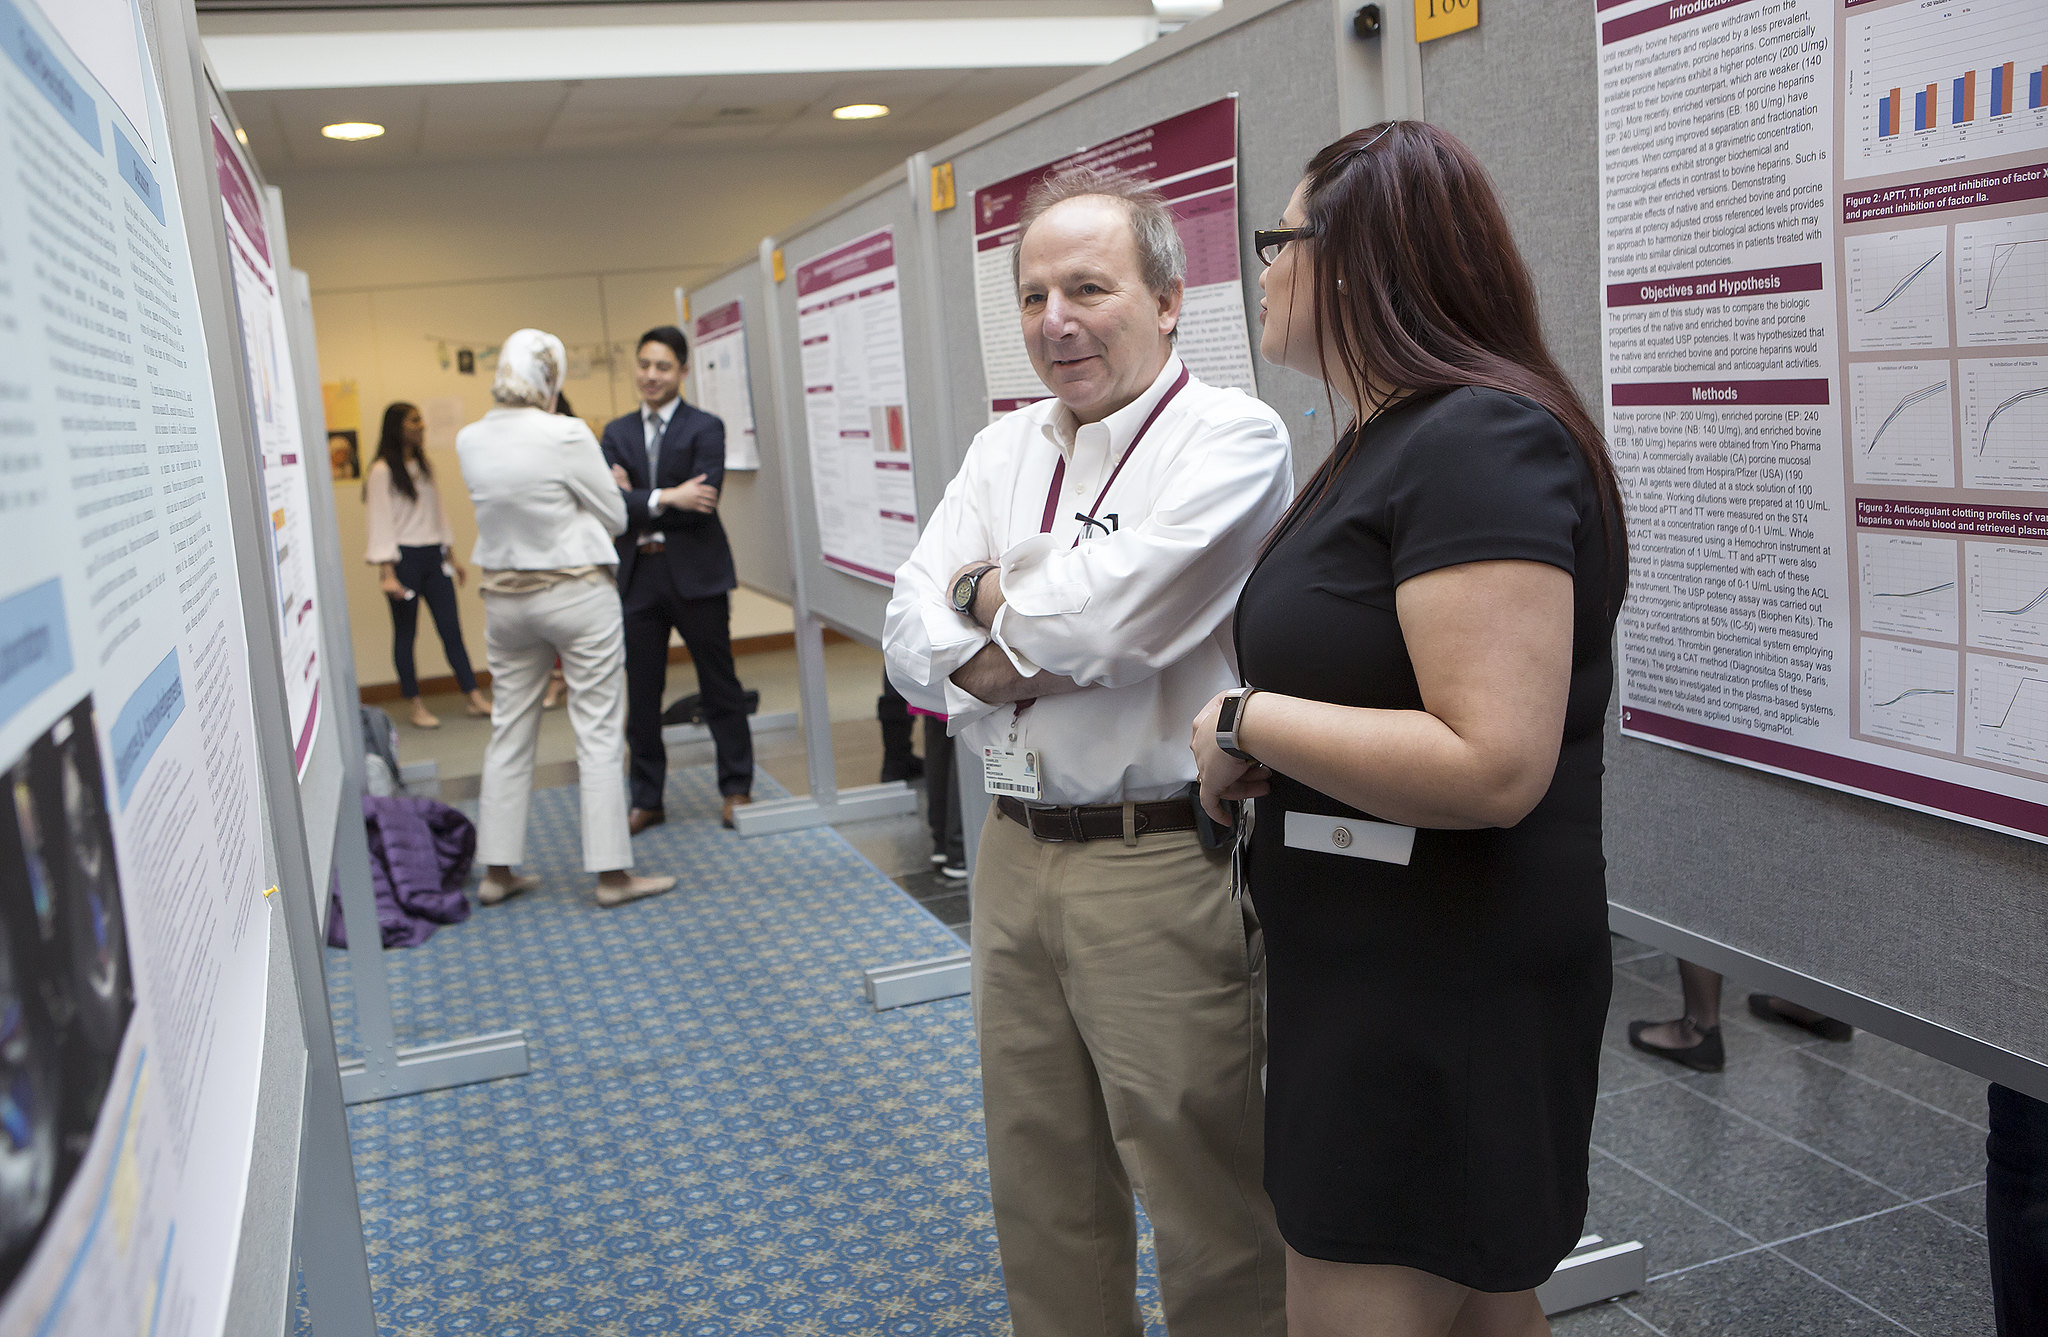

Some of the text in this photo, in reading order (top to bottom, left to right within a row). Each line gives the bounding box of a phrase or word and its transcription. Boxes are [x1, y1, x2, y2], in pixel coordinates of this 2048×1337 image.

[1670, 0, 1734, 20] Introduc
[1762, 0, 1795, 16] from the
[1750, 23, 1766, 35] less
[1758, 24, 1815, 48] Commercially
[1719, 36, 1827, 74] higher potency (200 U/mg)
[1769, 54, 1821, 76] weaker (140
[1746, 74, 1814, 99] porcine heparins
[1760, 91, 1807, 108] U/mg) have
[1710, 105, 1817, 135] separation and fractionation
[1715, 132, 1755, 150] gravimetric
[1727, 140, 1788, 161] biochemical and
[1795, 150, 1816, 164] Such
[1731, 173, 1785, 190] Demonstrating
[1748, 183, 1822, 202] bovine and porcine
[1846, 197, 1871, 207] Figure
[1873, 193, 1880, 203] 2:
[1882, 190, 1906, 201] APTT,
[1909, 188, 1921, 198] TT,
[1923, 183, 1956, 197] percent
[1958, 178, 1999, 190] inhibition
[2002, 174, 2011, 184] of
[2013, 172, 2040, 182] factor
[1724, 198, 1824, 220] referenced levels provides
[1845, 209, 1860, 219] and
[1862, 205, 1892, 219] percent
[1895, 201, 1934, 213] inhibition
[1937, 198, 1945, 207] of
[1947, 196, 1974, 206] factor
[1776, 215, 1818, 228] which may
[1744, 228, 1821, 249] patients treated with
[1657, 259, 1693, 272] equivalent
[1640, 274, 1780, 302] Objectives and Hypothesis
[1732, 298, 1809, 313] compare the biologic
[1761, 313, 1805, 326] and porcine
[1756, 327, 1824, 341] hypothesized that
[1730, 342, 1817, 357] porcine heparins would
[1717, 361, 1731, 370] and
[1733, 359, 1782, 370] anticoagulant
[1692, 386, 1737, 400] Methods
[1784, 411, 1818, 422] (EP: 240
[1760, 426, 1820, 435] enriched bovine
[1752, 440, 1820, 450] from Yino Pharma
[1748, 454, 1810, 465] porcine mucosal
[1706, 466, 1802, 480] Hospira/Pfizer (USA) (190
[1796, 484, 1812, 494] 100
[1777, 512, 1807, 523] the ST4
[1858, 502, 1882, 513] Figure
[1884, 503, 1891, 512] 3:
[1894, 504, 1949, 516] Anticoagulant
[1952, 508, 1984, 520] clotting
[1987, 511, 2020, 520] profiles
[2023, 512, 2032, 521] of
[1858, 513, 1891, 524] heparins
[1906, 517, 1929, 526] whole
[1932, 519, 1955, 528] blood
[1958, 521, 1973, 530] and
[1976, 523, 2015, 533] retrieved
[1788, 528, 1814, 539] Whole
[1779, 541, 1820, 554] instrument
[1778, 557, 1816, 568] were also
[1787, 571, 1809, 582] these
[1797, 586, 1828, 599] the ACL
[1762, 598, 1821, 612] was carried out
[1816, 617, 1832, 628] The
[1758, 625, 1817, 640] were measured
[1716, 630, 1833, 660] biochemical system employing
[1790, 658, 1831, 672] assay was
[1790, 685, 1811, 697] these
[1745, 690, 1798, 708] plasma-based
[1732, 715, 1751, 728] using
[1763, 708, 1819, 727] and applicable
